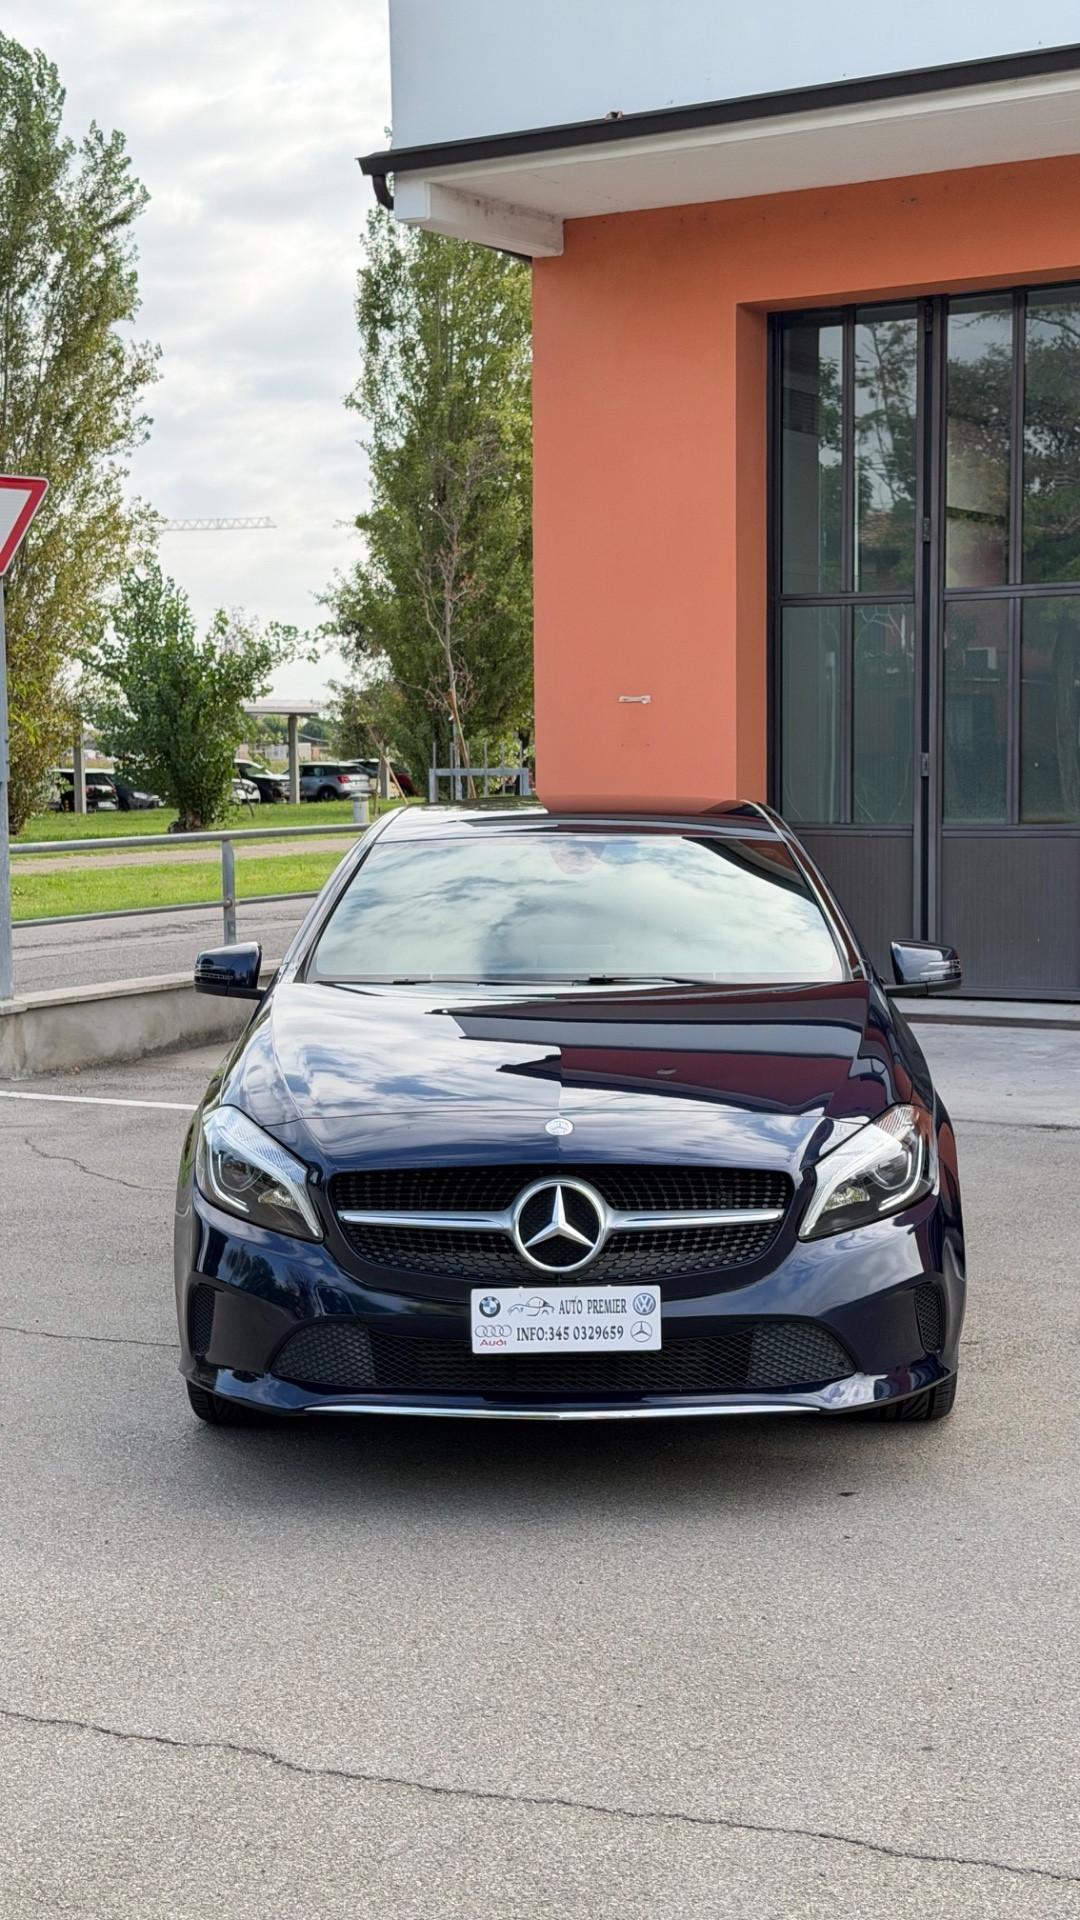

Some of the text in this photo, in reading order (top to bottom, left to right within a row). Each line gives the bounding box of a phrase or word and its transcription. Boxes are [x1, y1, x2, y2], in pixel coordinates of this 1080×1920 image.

[558, 1298, 628, 1315] AUTO PREMIER
[516, 1325, 624, 1342] INFO:345 0329659
[479, 1338, 507, 1347] Audi
